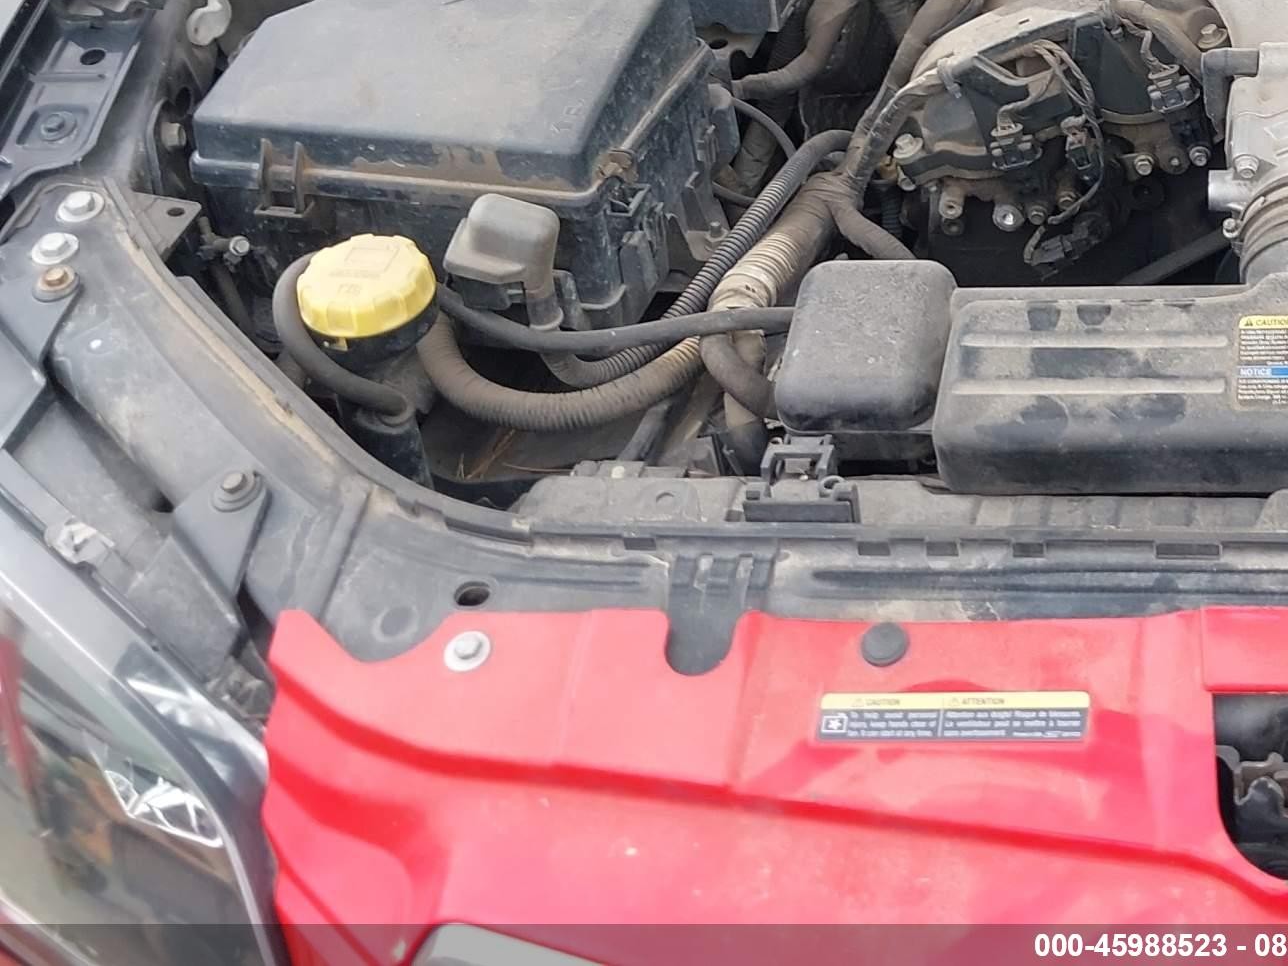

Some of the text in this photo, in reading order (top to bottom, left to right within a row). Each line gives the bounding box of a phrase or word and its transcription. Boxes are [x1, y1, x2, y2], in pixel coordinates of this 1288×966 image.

[1239, 367, 1272, 376] NOTICE
[865, 698, 900, 706] CAUTION
[962, 697, 1005, 705] ATTENTION
